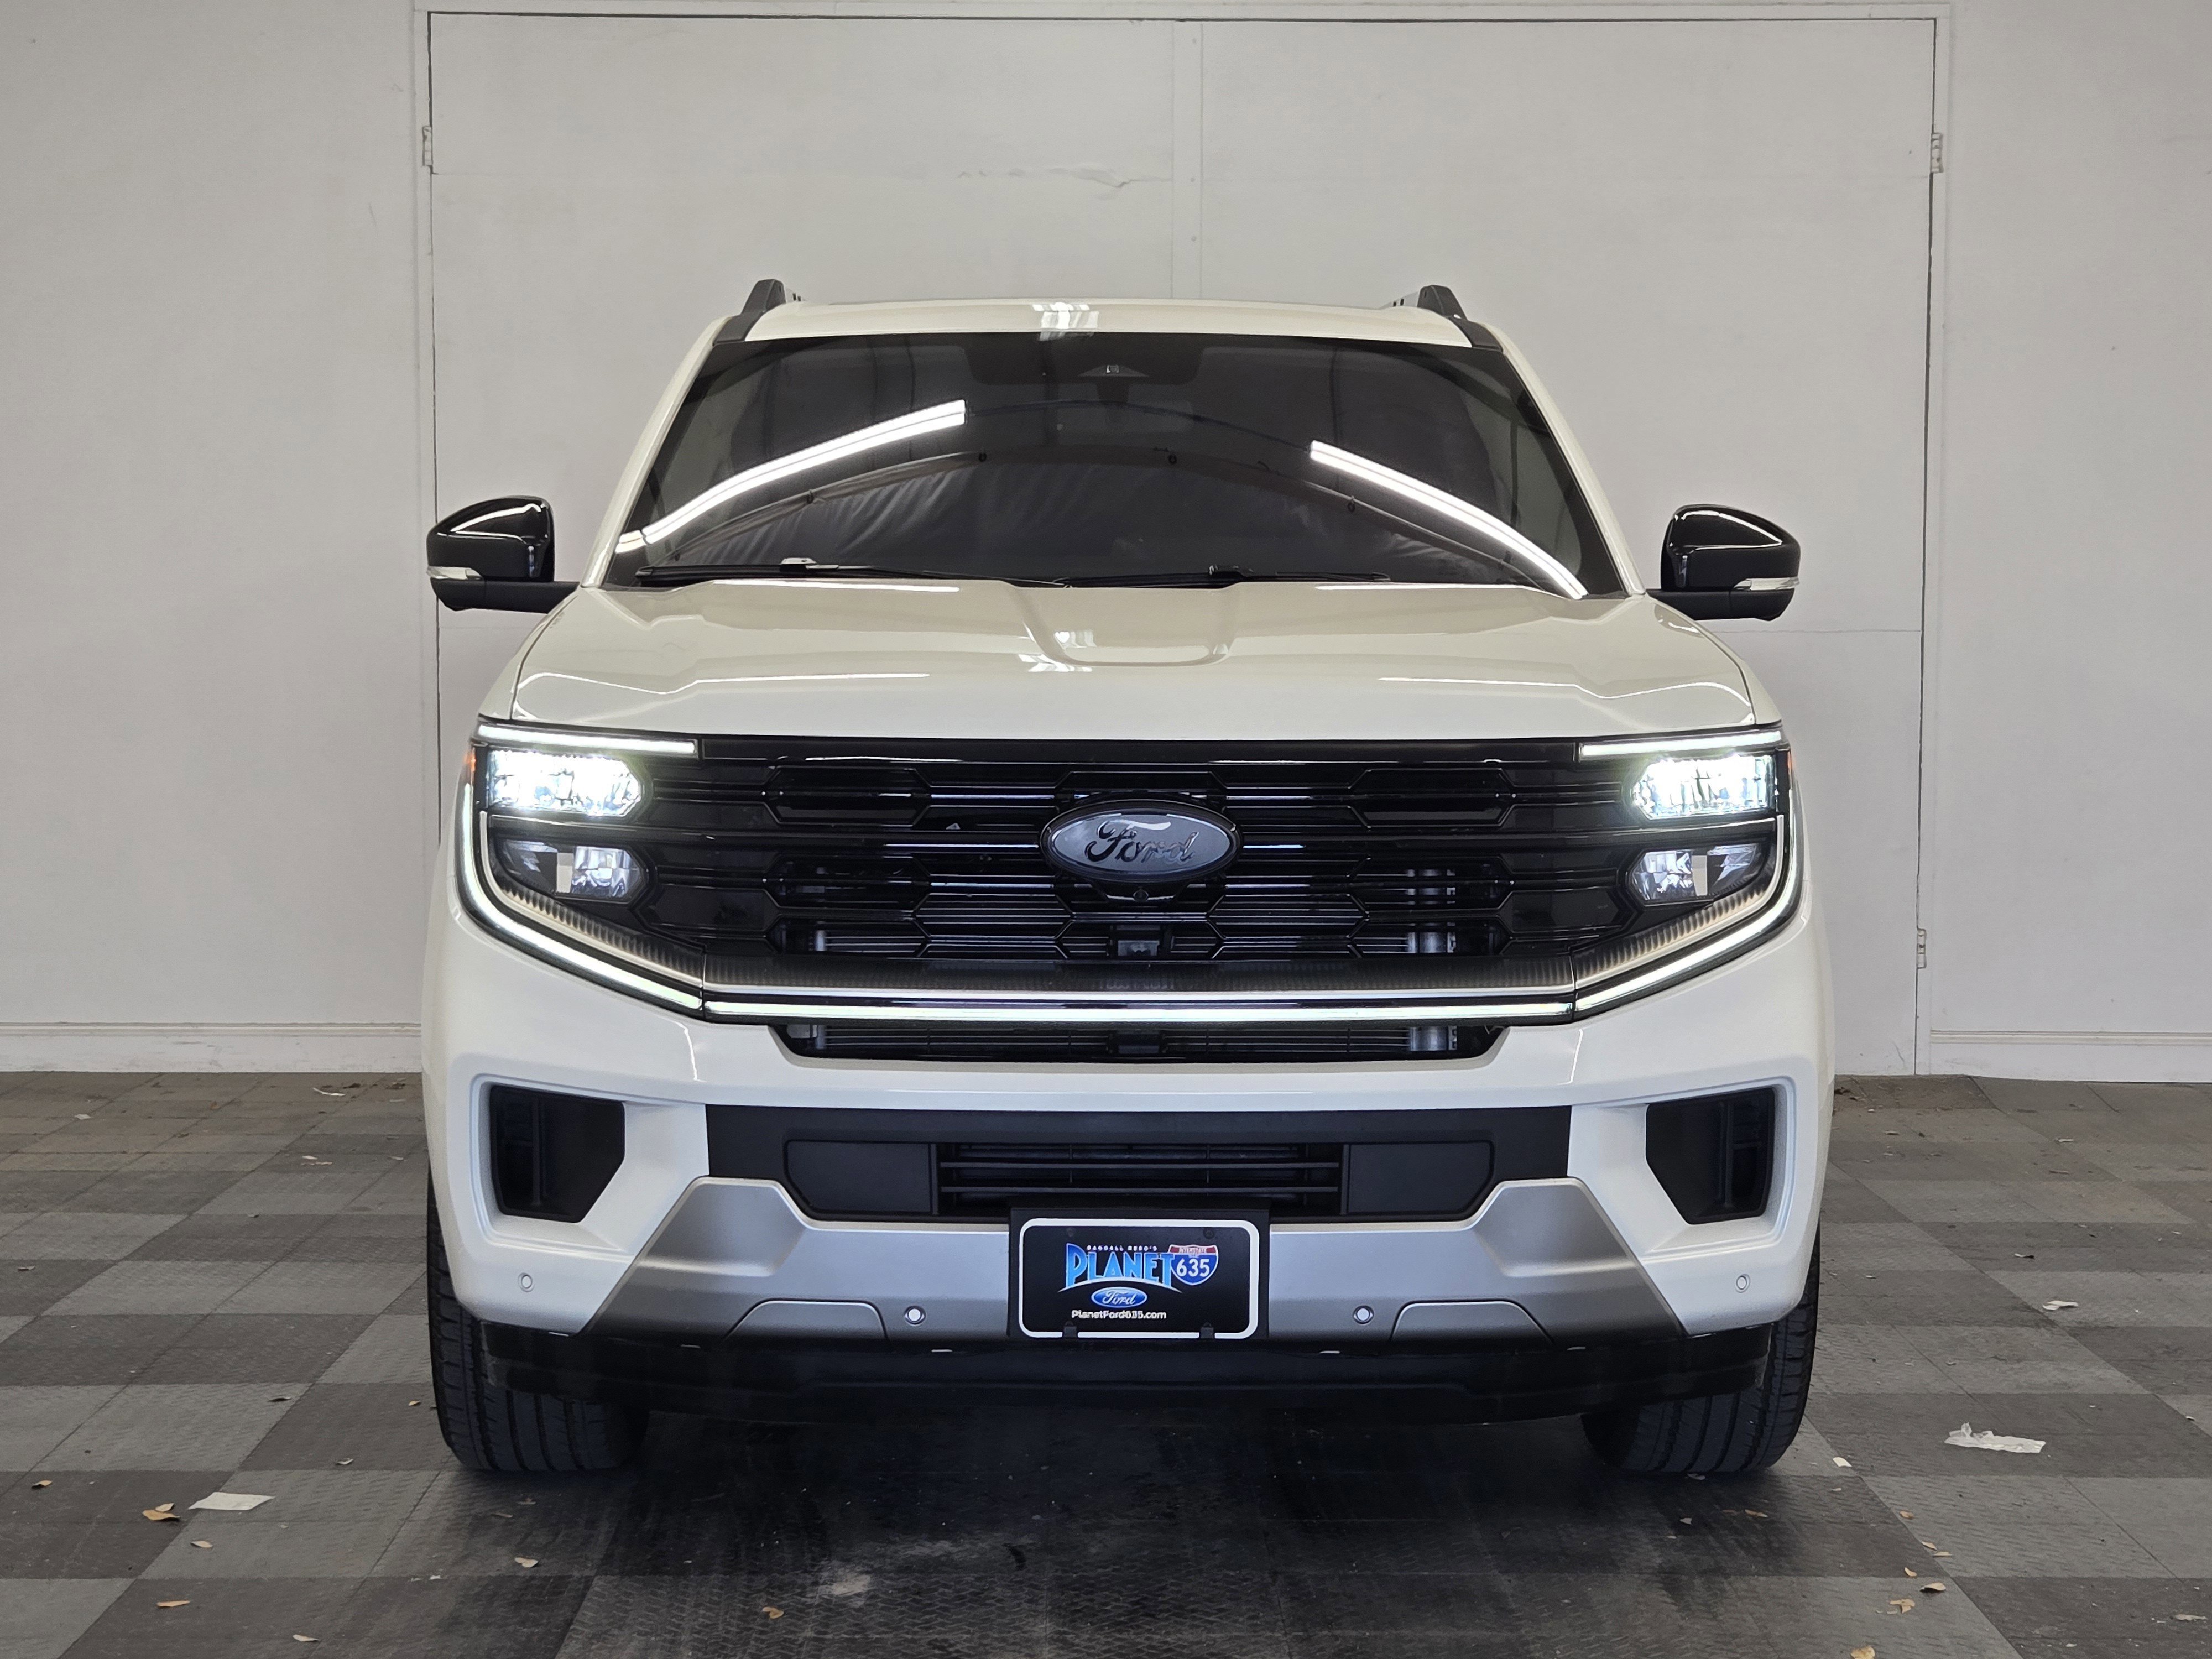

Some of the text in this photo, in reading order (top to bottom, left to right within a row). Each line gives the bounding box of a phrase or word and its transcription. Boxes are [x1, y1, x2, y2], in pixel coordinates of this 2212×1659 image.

[1084, 820, 1199, 862] Ford
[1066, 1243, 1175, 1288] PLANET
[1176, 1258, 1210, 1277] 635
[1102, 1290, 1136, 1305] Ford
